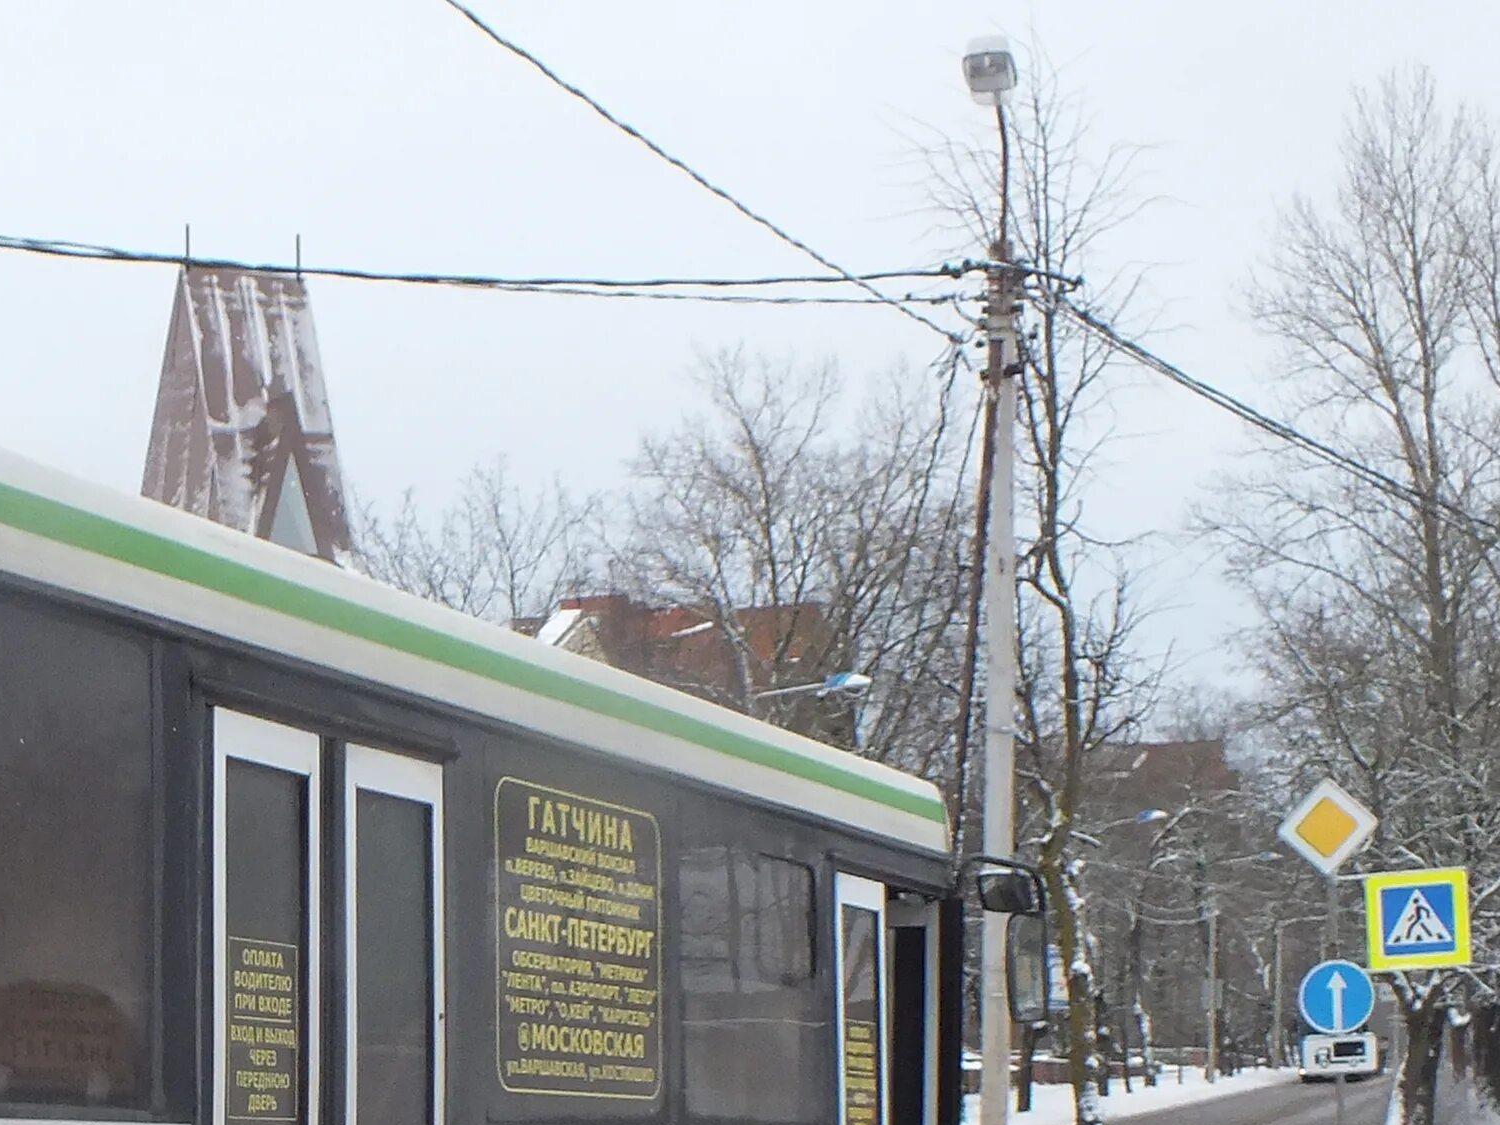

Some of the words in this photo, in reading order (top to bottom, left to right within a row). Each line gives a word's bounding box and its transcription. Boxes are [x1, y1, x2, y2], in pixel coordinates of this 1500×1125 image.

[527, 796, 633, 852] ГАТЧИНА
[505, 906, 655, 959] САНКТ-ПЕТЕРБУРГ
[242, 949, 284, 968] ОПЛАТА
[234, 970, 292, 992] ВОДИТЕЛЮ
[235, 993, 256, 1011] ПРИ
[258, 995, 292, 1017] ВХОДЕ
[231, 1025, 255, 1044] ВХОД
[264, 1027, 296, 1048] ВЫХОД
[532, 1023, 644, 1058] МОСКОВСКАЯ
[250, 1050, 277, 1066] ЧЕРЕЗ
[236, 1071, 290, 1092] ПЕРЕДНЮЮ
[248, 1094, 277, 1112] ДВЕРЬ
